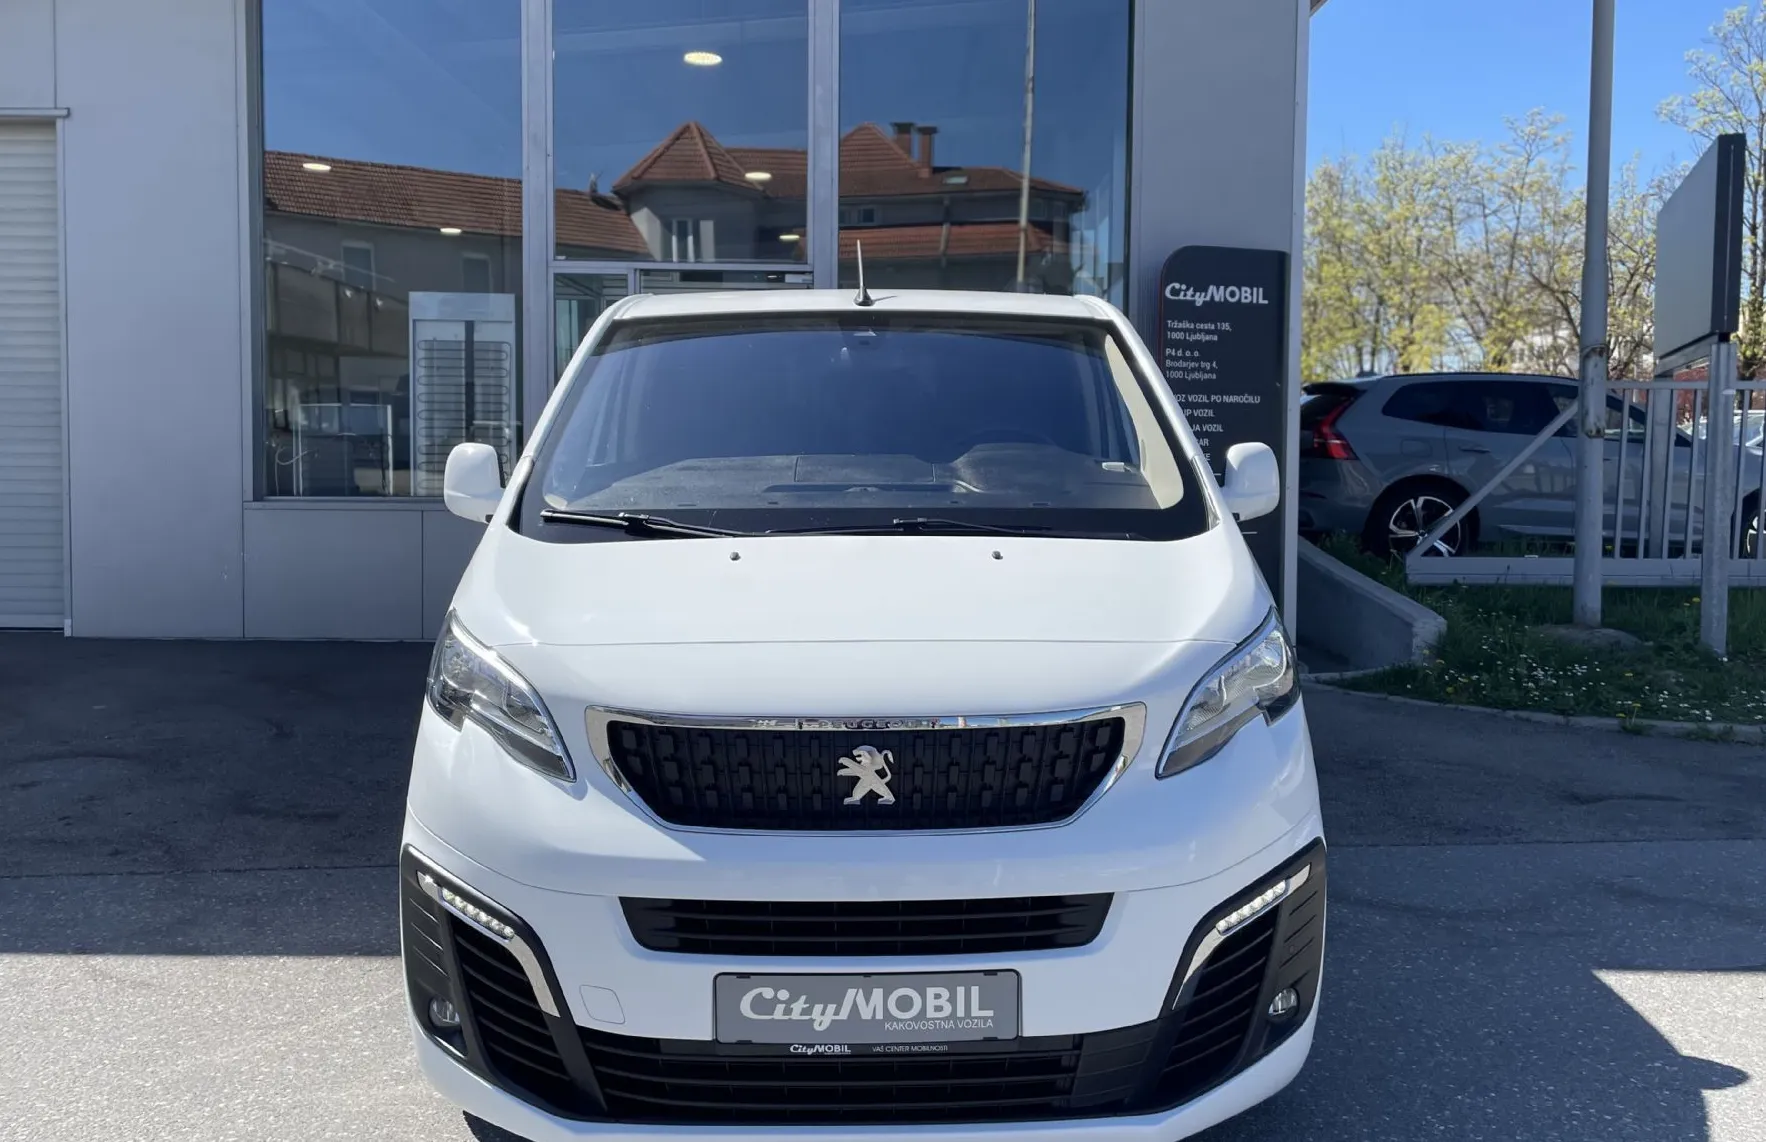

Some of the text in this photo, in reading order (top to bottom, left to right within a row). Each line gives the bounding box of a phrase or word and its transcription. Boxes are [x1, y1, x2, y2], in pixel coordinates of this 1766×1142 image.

[1165, 282, 1269, 306] CityMOBIL
[1167, 320, 1195, 329] Tržaška
[1217, 322, 1232, 332] 135,
[1167, 331, 1218, 342] 1000 Ljubljana
[1166, 348, 1176, 356] P4
[1166, 359, 1199, 370] Brodarjev
[1200, 361, 1211, 370] trg
[1166, 370, 1217, 381] 1000 Ljubljana
[1187, 394, 1210, 403] VOZIL
[1211, 394, 1222, 403] PO
[1223, 393, 1261, 404] NAROČILU
[1193, 409, 1215, 418] VOZIL
[1202, 424, 1224, 433] VOZIL
[819, 719, 918, 730] PEUGEOT
[739, 985, 994, 1031] CityMOBIL
[884, 1018, 994, 1031] KAKOVOSTNA VOZILA
[789, 1044, 852, 1055] CityMOBIL
